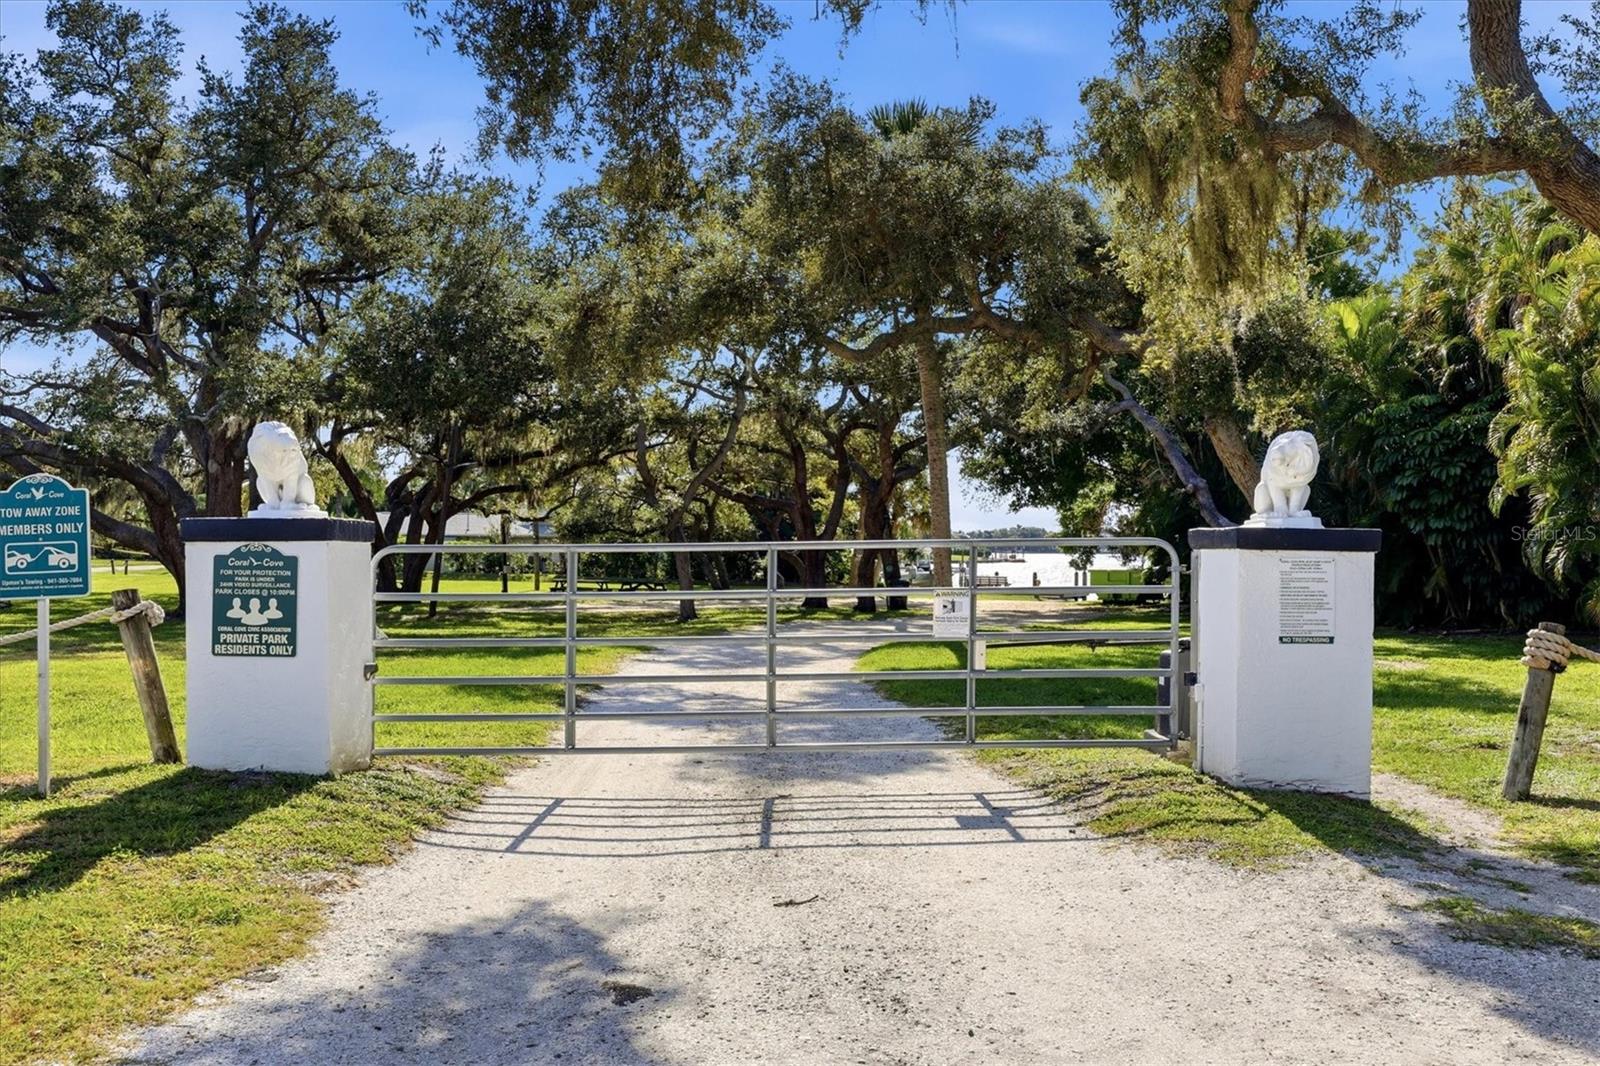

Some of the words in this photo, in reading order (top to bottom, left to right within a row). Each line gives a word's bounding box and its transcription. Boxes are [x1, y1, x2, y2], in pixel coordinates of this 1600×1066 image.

[15, 491, 31, 500] Coral
[48, 490, 65, 498] Cove
[0, 507, 23, 518] TOW
[25, 506, 53, 518] AWAY
[55, 505, 81, 516] ZONE
[0, 523, 53, 536] MEMBERS
[55, 521, 84, 534] ONLY
[227, 557, 250, 567] Coral
[262, 558, 284, 567] Cove
[252, 569, 291, 577] PROTECTION
[261, 589, 269, 597] @
[219, 633, 260, 644] PRIVATE
[261, 633, 289, 645] PARK
[214, 644, 268, 655] RESIDENTS
[269, 645, 294, 656] ONLY
